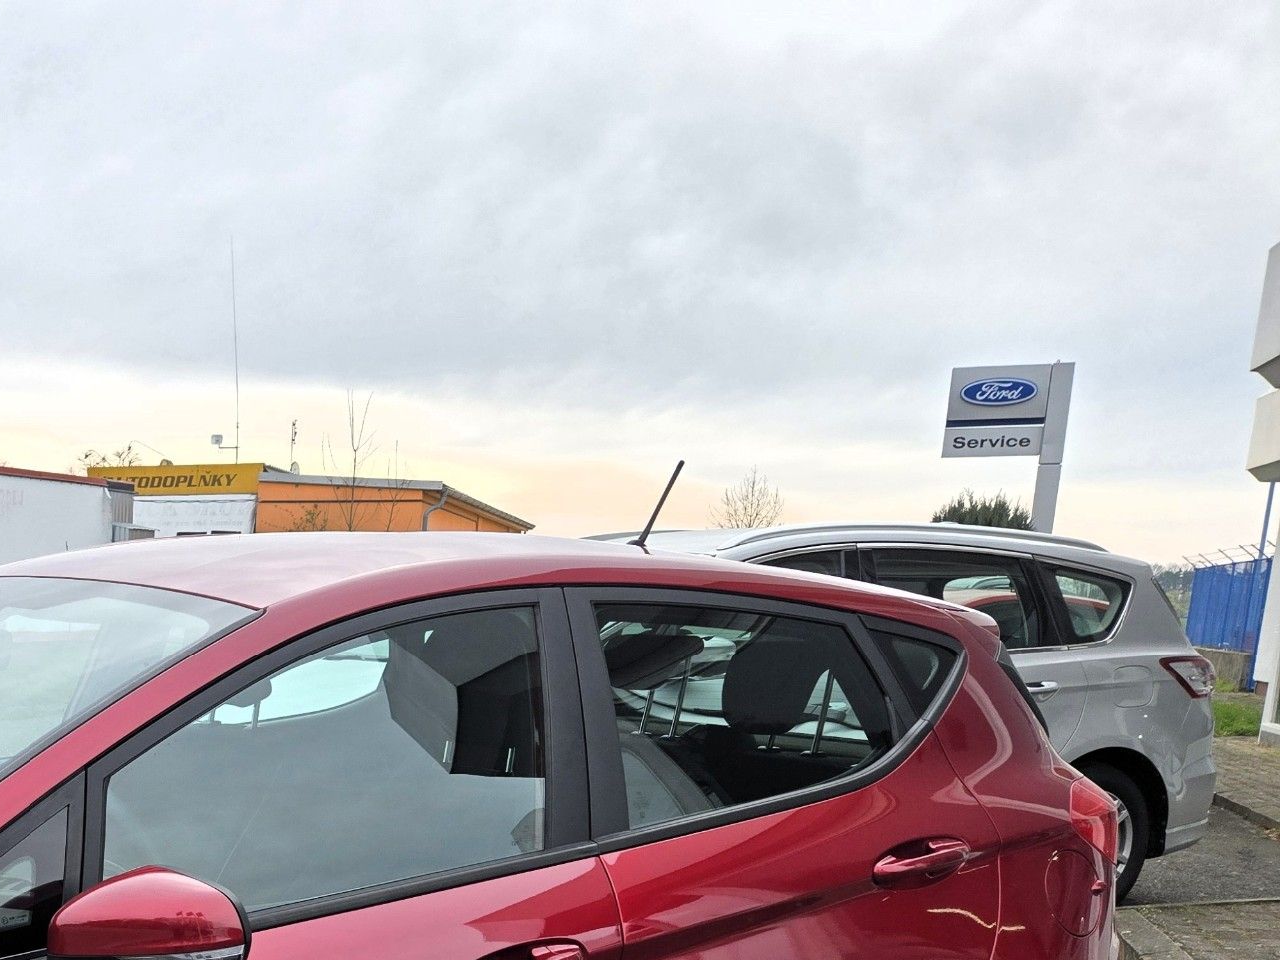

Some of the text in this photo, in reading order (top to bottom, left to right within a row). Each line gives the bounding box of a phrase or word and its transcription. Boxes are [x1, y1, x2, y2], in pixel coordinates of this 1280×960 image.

[975, 382, 1023, 401] Ford
[952, 435, 1031, 449] Service
[106, 471, 237, 489] TODOPLŇKY
